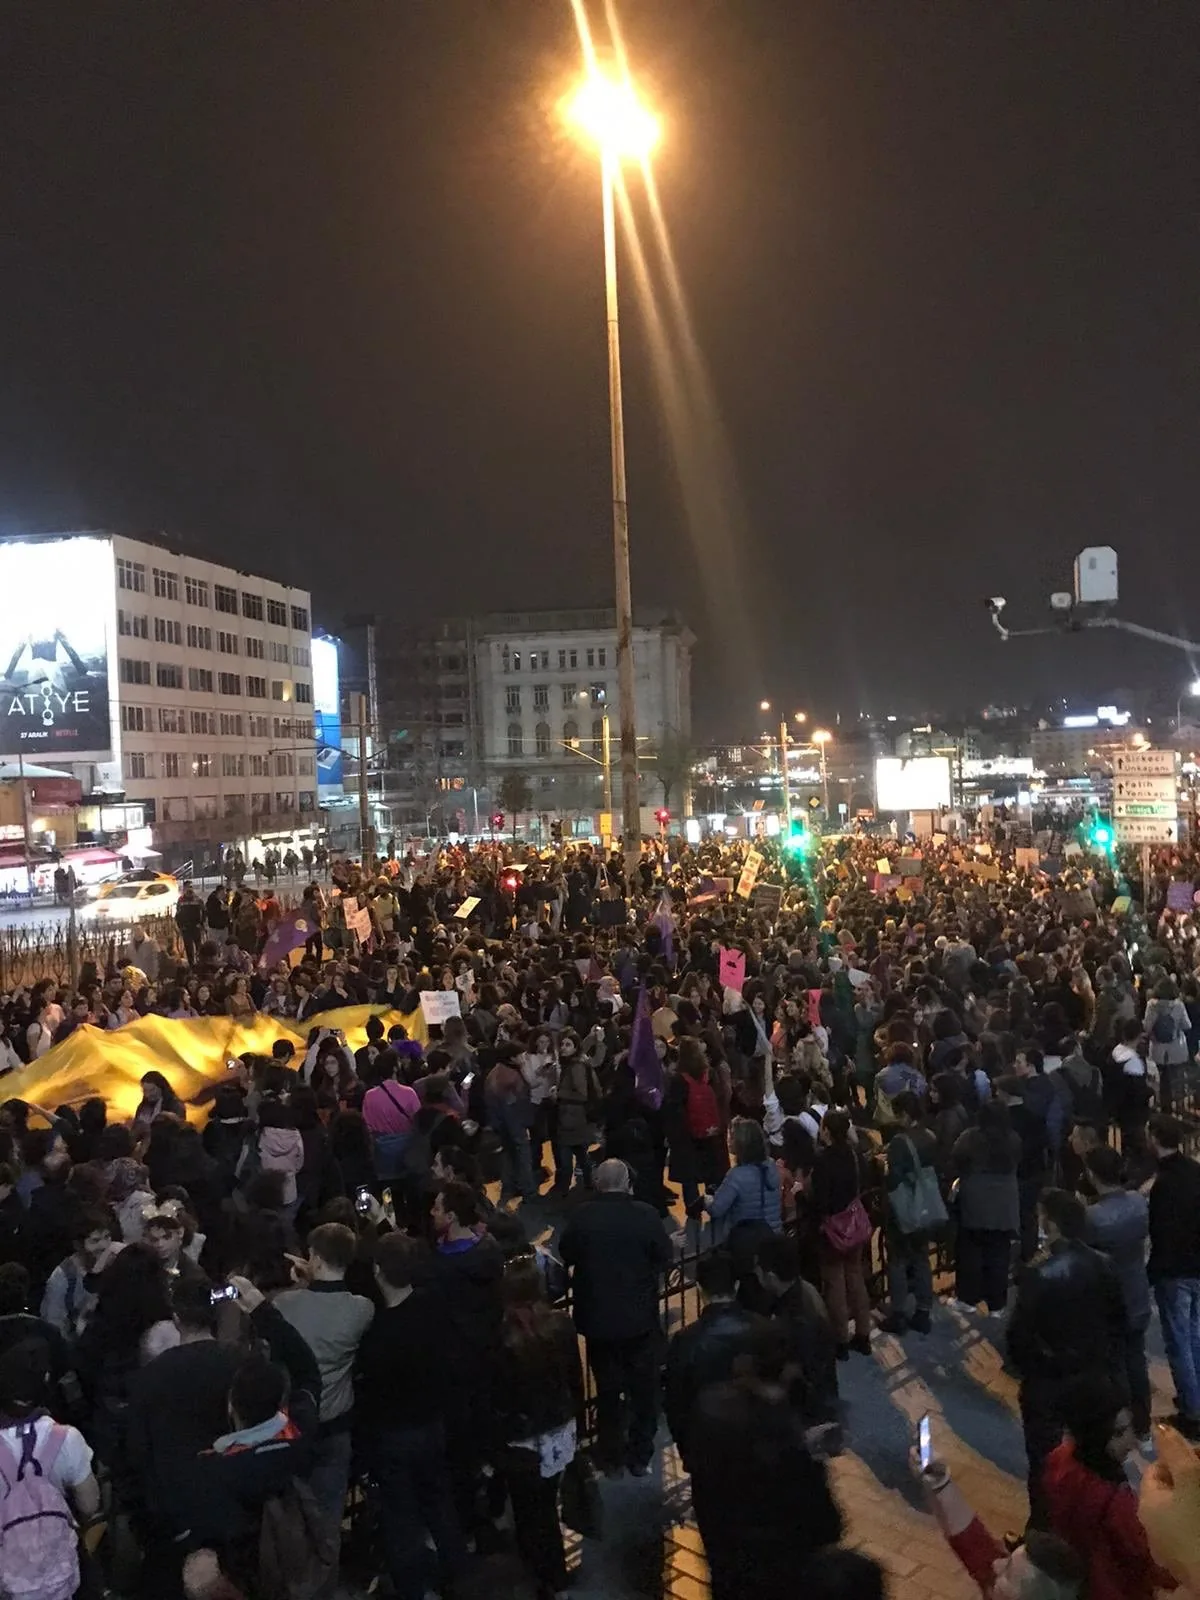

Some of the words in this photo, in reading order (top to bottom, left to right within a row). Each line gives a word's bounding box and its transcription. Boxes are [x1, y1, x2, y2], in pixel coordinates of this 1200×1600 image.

[1125, 754, 1165, 762] Sirkeci
[1125, 780, 1153, 788] Fatih
[1118, 823, 1157, 832] Taksim
